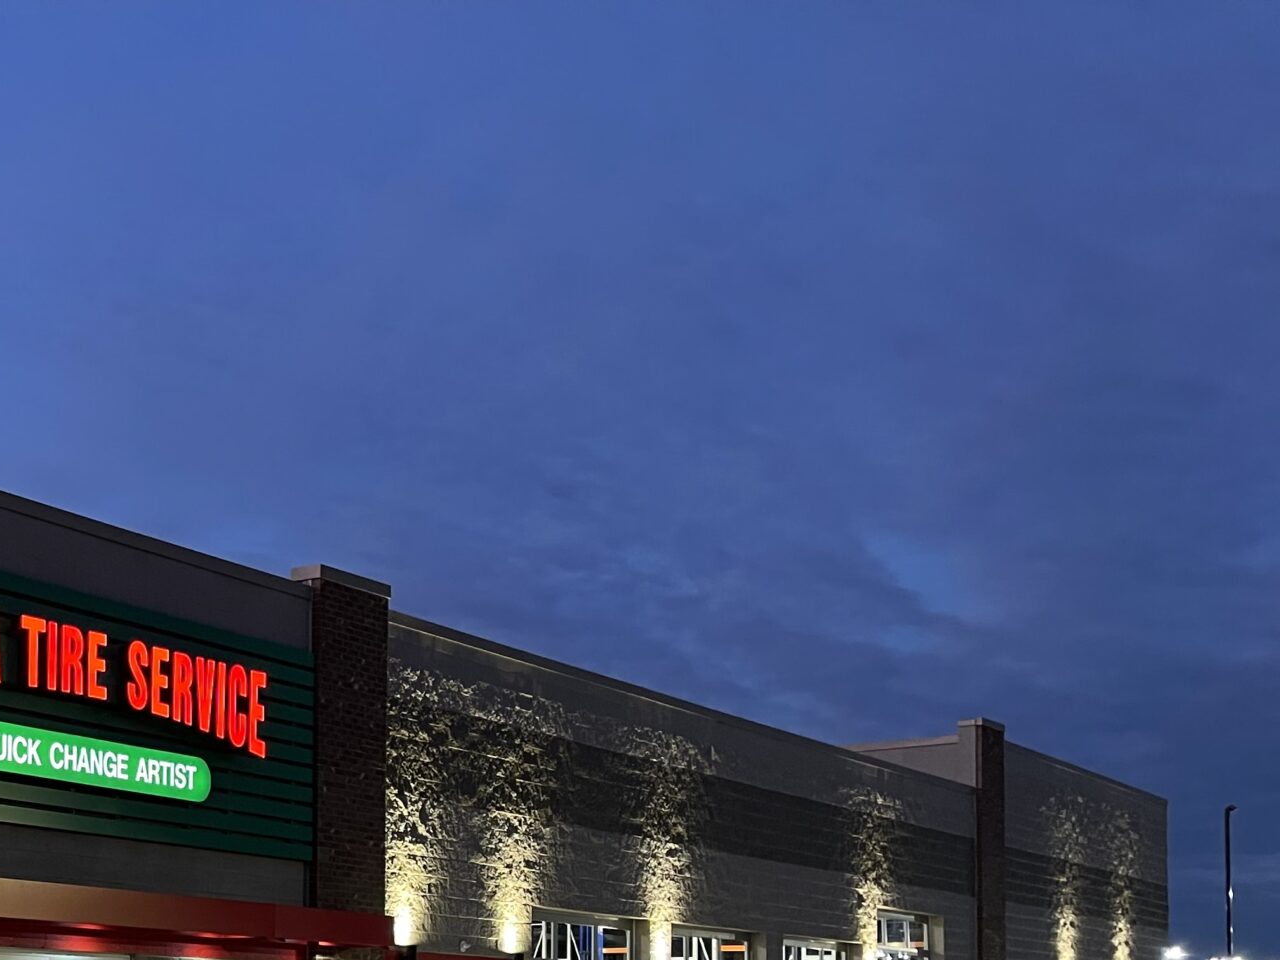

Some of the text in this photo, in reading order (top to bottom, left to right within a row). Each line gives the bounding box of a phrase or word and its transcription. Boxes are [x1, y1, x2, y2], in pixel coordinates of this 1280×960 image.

[20, 613, 108, 701] TIRE
[126, 640, 268, 759] SERVICE
[49, 742, 129, 781] CHANGE
[135, 756, 198, 791] ARTIST
